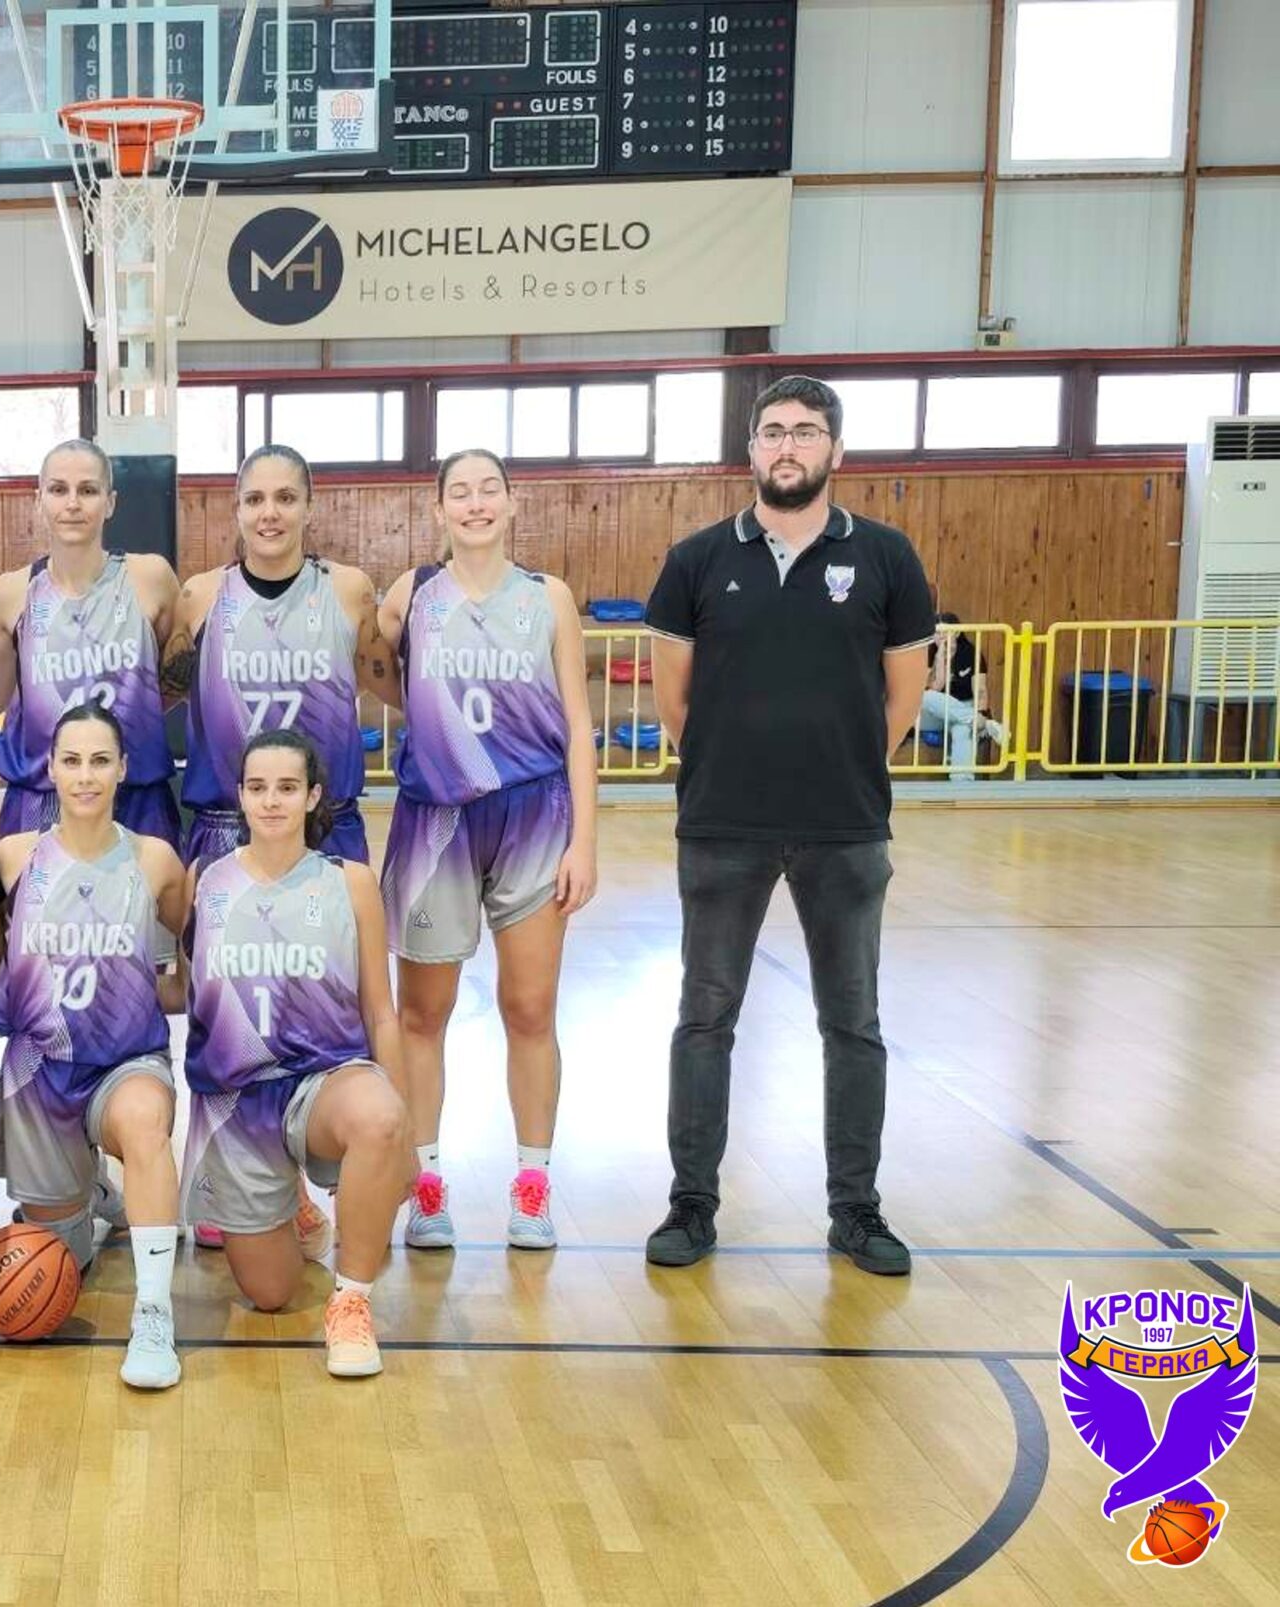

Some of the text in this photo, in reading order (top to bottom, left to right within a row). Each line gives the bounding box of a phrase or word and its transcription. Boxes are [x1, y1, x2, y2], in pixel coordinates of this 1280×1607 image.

[625, 19, 637, 36] 4
[709, 15, 728, 34] 10
[86, 35, 97, 52] 4
[166, 32, 185, 50] 10
[708, 41, 725, 58] 11
[624, 43, 636, 60] 5
[86, 60, 97, 76] 5
[166, 58, 183, 74] 11
[707, 65, 726, 82] 12
[546, 69, 597, 85] FOULS
[623, 68, 635, 85] 6
[86, 84, 97, 101] 6
[166, 81, 185, 98] 12
[530, 96, 597, 113] GUEST
[623, 92, 634, 109] 7
[706, 90, 725, 107] 13
[622, 117, 633, 134] 8
[705, 114, 724, 132] 14
[621, 141, 633, 158] 9
[705, 138, 724, 156] 15
[357, 222, 650, 257] MICHELANGELO
[360, 274, 646, 302] Hotels & Resorts
[32, 638, 139, 685] KRONOS
[421, 646, 535, 683] KRONOS
[241, 691, 303, 738] 77
[463, 687, 493, 734] 0
[21, 921, 136, 957] KRONOS
[206, 943, 327, 981] KRONOS
[52, 963, 98, 1012] 10
[253, 985, 271, 1038] 1
